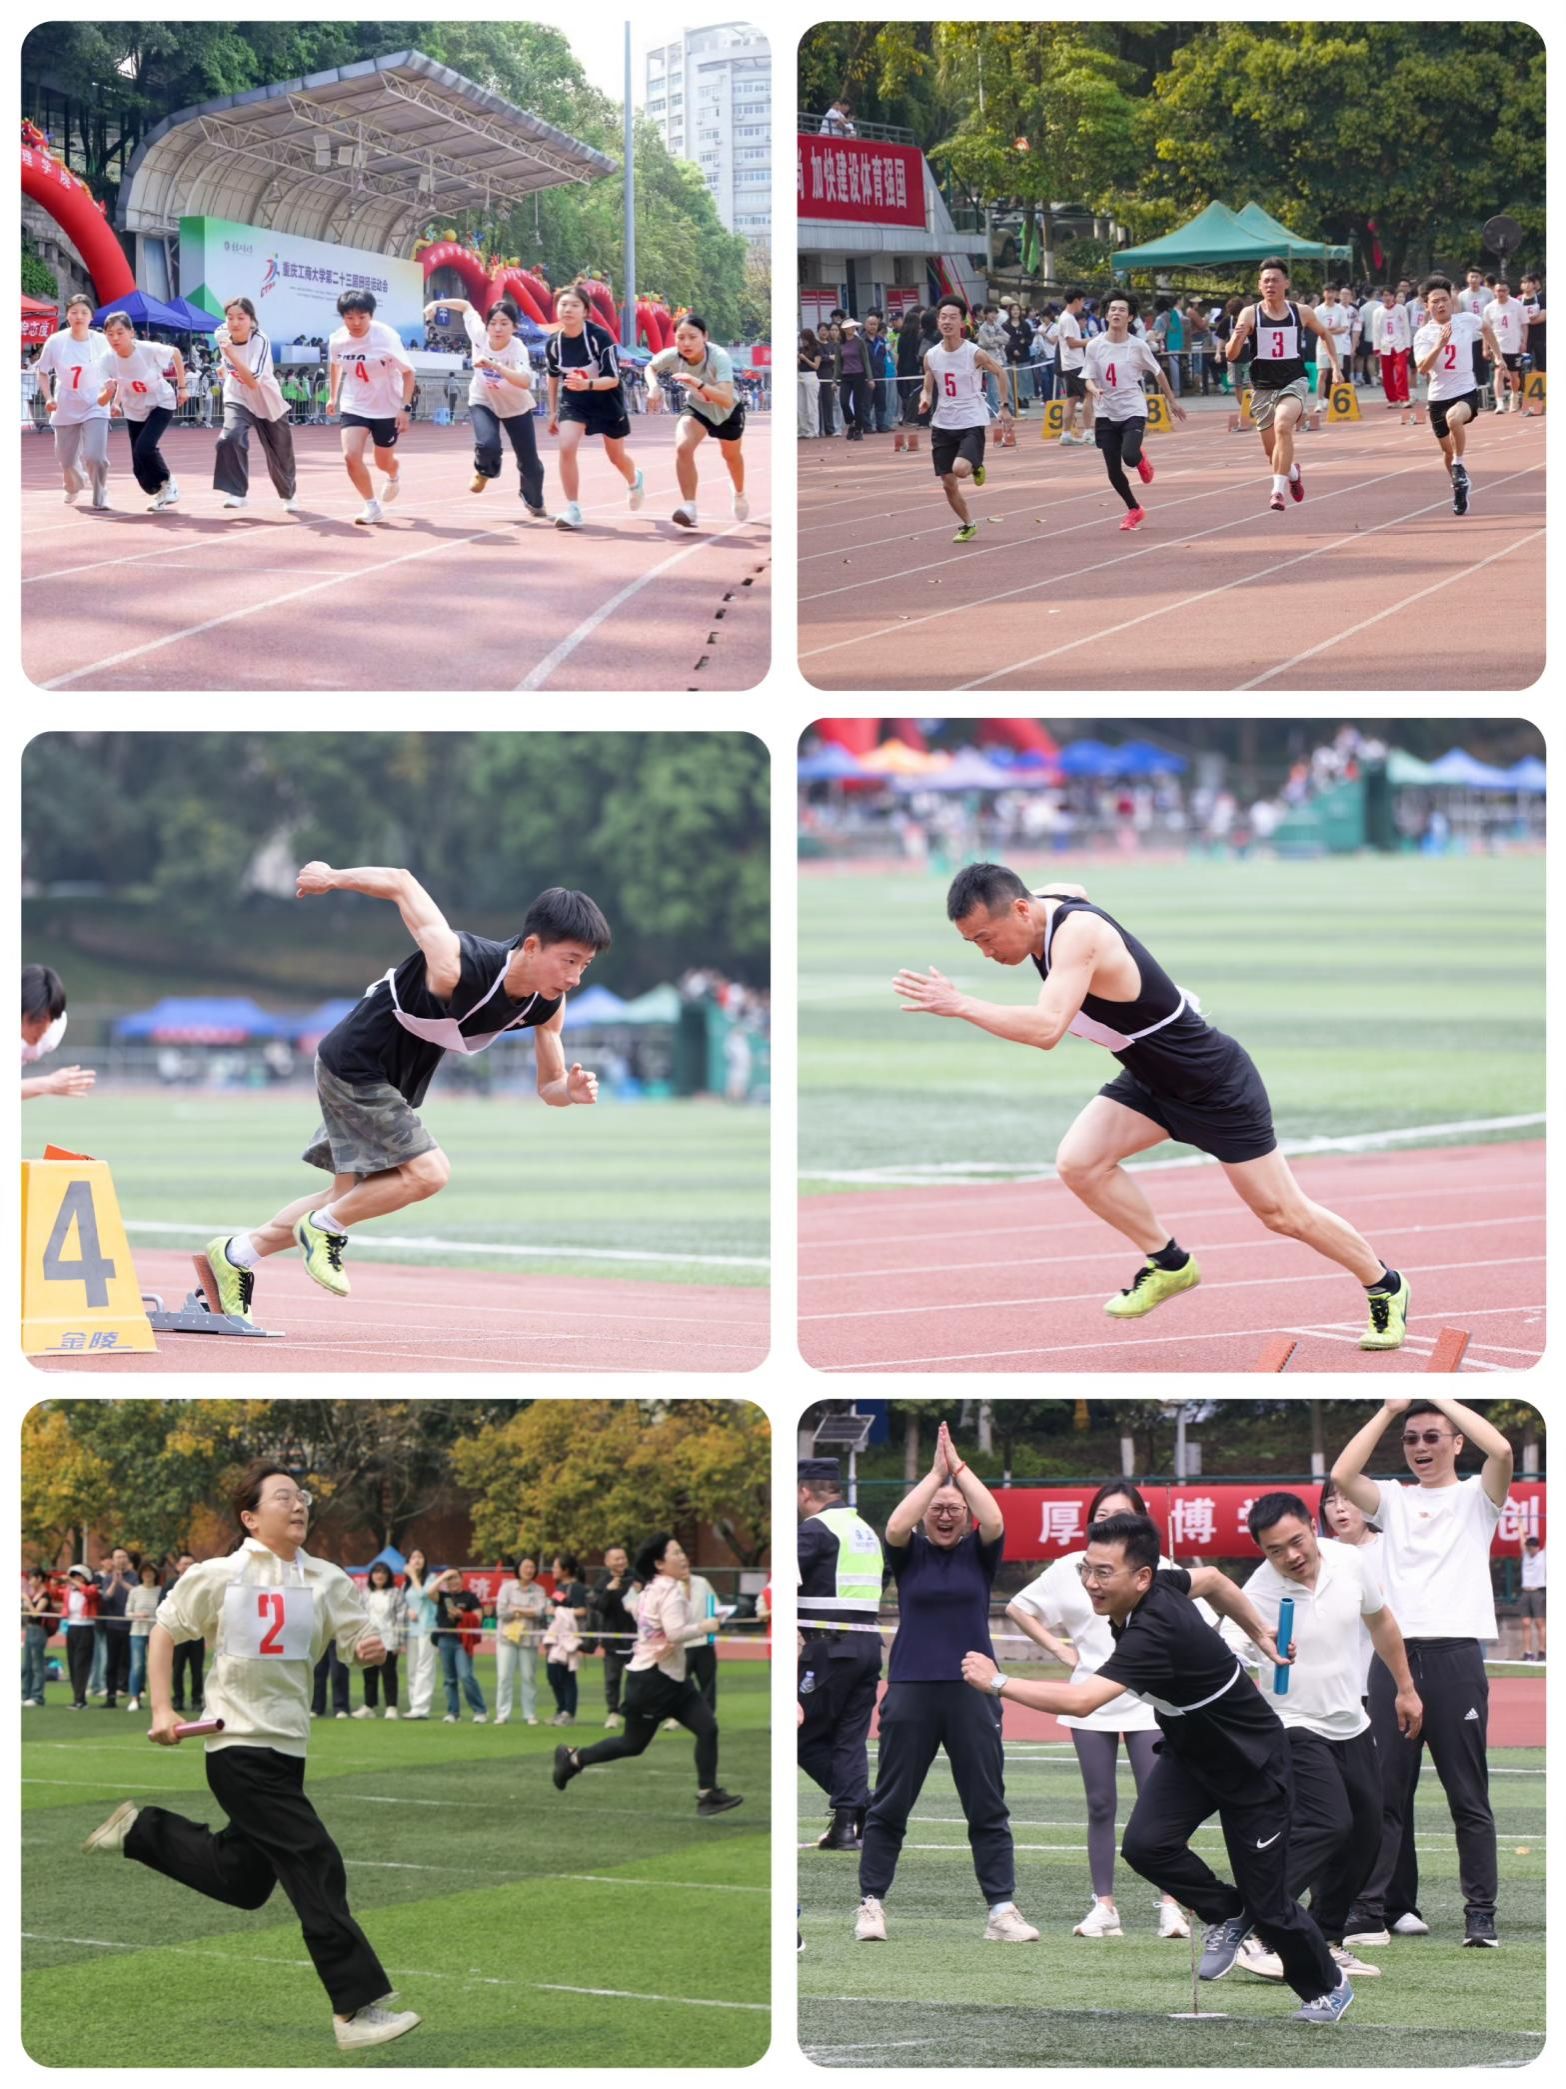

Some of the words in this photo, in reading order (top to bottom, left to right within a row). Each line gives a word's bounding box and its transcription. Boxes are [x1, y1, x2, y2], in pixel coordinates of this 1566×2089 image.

[811, 145, 907, 208] 加快建设体育强国
[1501, 315, 1509, 329] 4
[1271, 331, 1284, 358] 3
[1444, 345, 1456, 369] 2
[71, 366, 82, 389] 7
[355, 361, 369, 383] 4
[944, 372, 957, 397] 5
[1105, 362, 1117, 387] 4
[131, 380, 147, 393] 6
[1528, 377, 1546, 400] 4
[1147, 398, 1162, 424] 8
[1333, 388, 1351, 414] 6
[1049, 404, 1064, 430] 9
[43, 1181, 116, 1308] 4
[61, 1331, 119, 1349] 金陵
[258, 1594, 285, 1655] 2
